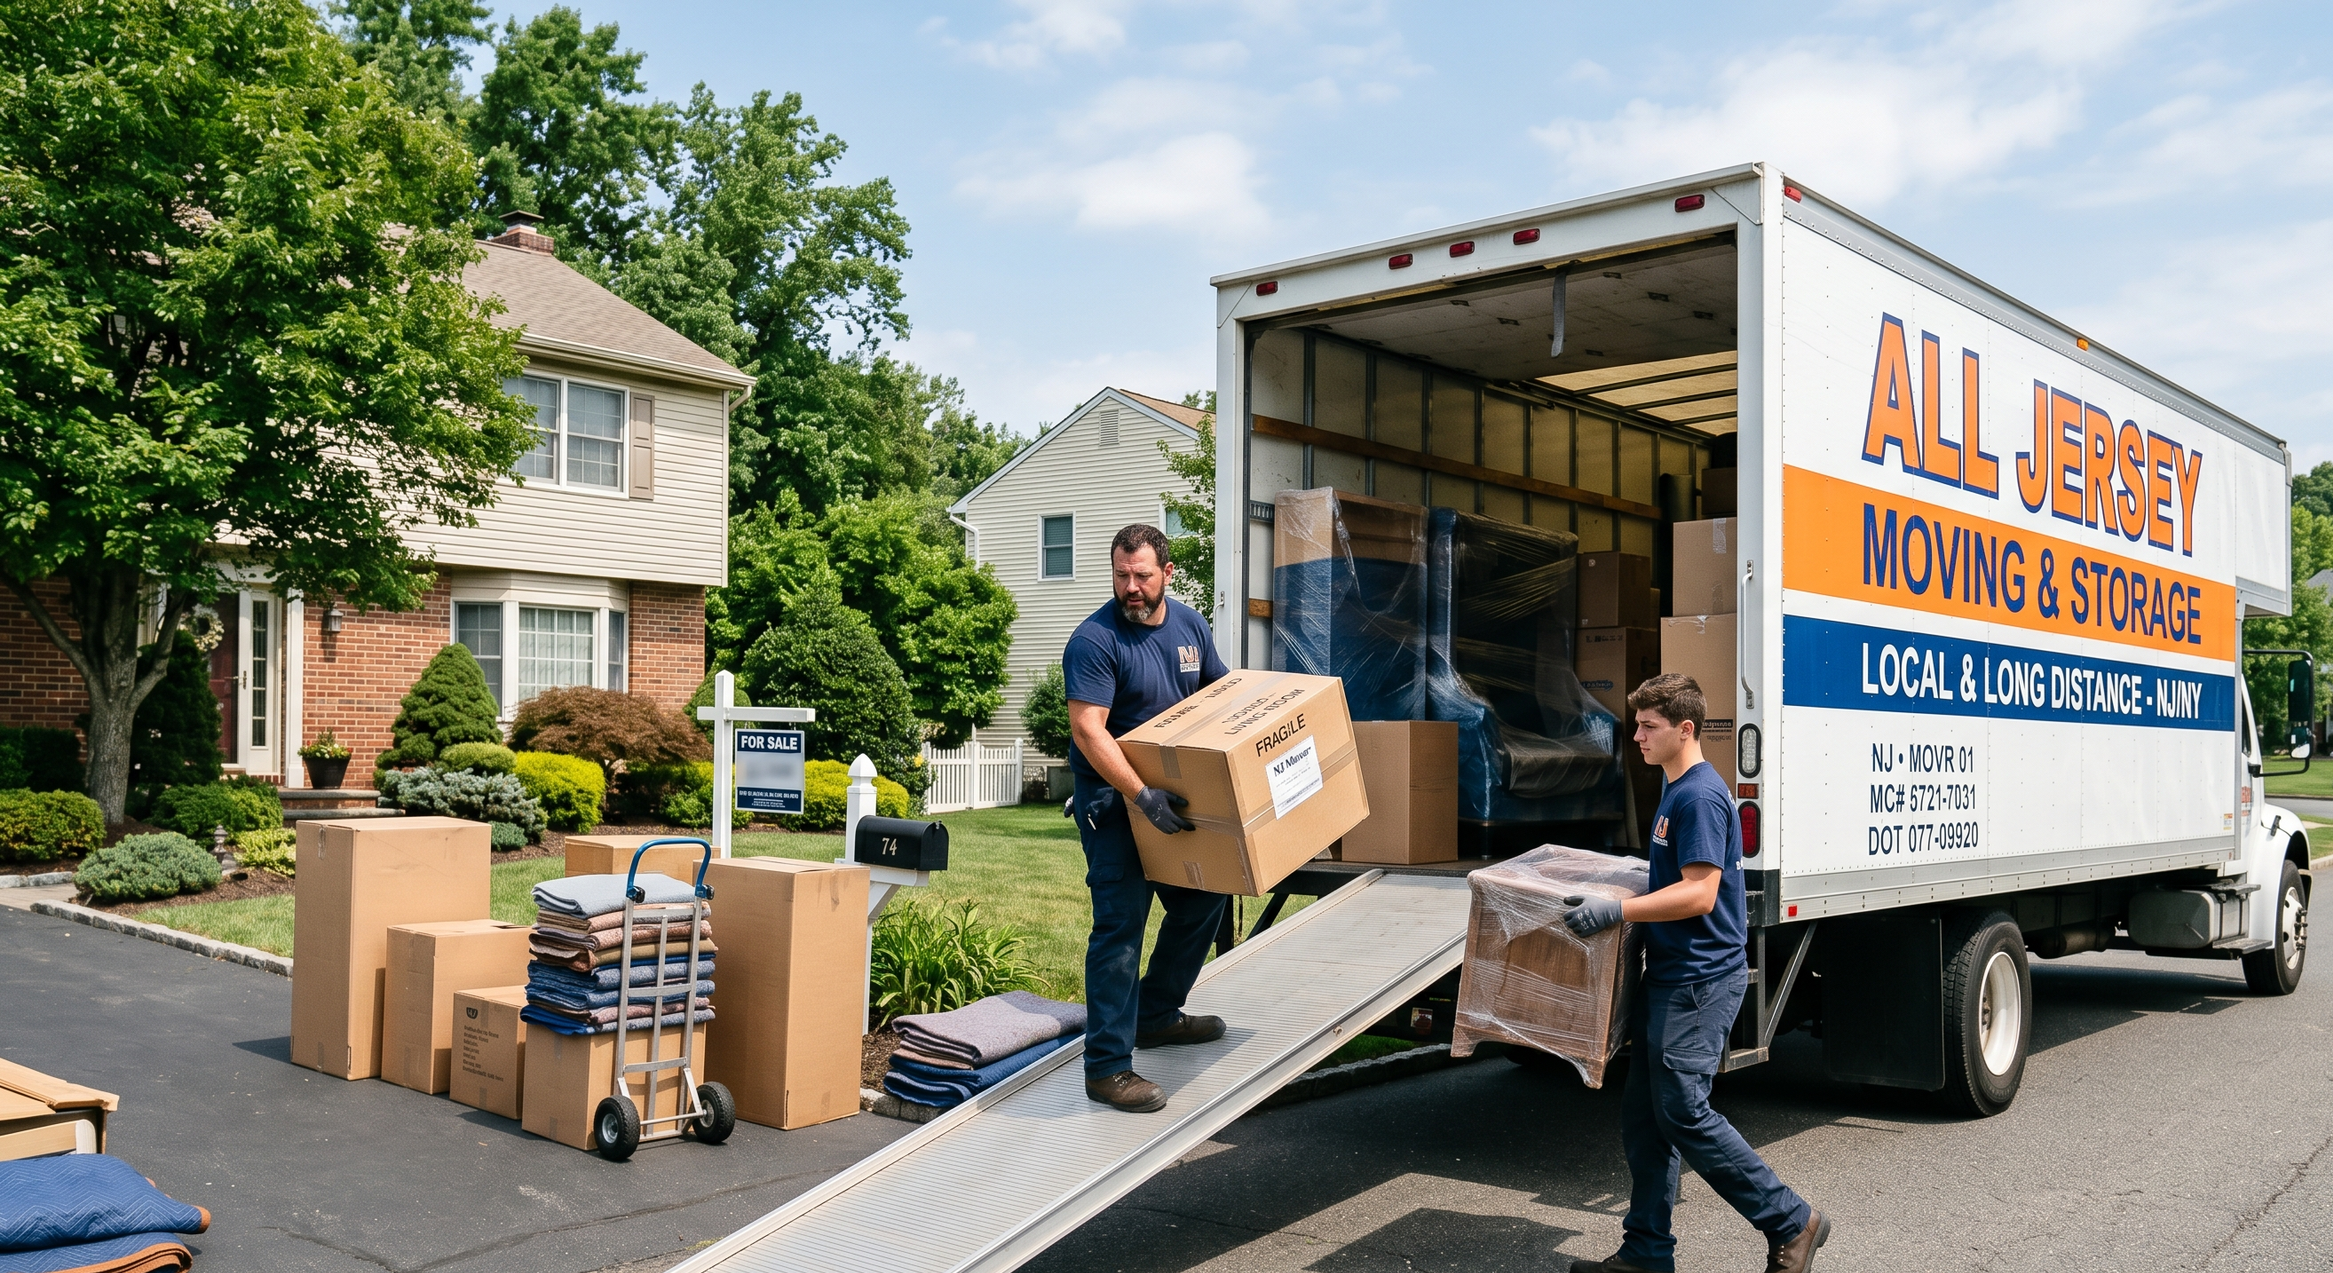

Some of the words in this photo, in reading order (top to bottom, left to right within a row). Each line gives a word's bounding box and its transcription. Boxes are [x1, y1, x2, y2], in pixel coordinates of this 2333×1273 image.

[1861, 312, 1999, 500] ALL
[2016, 378, 2203, 557] JERSEY
[1863, 502, 2025, 613] MOVING
[2038, 548, 2059, 619] &
[2071, 557, 2202, 645] STORAGE
[1862, 642, 1953, 700] LOCAL
[1960, 654, 1977, 702] &
[1983, 657, 2045, 708] LONG
[2051, 665, 2142, 715] DISTANCE
[741, 735, 765, 749] FOR
[767, 736, 798, 750] SALE
[1255, 713, 1306, 757] FRAGILE
[1872, 743, 1893, 773] NJ
[1909, 744, 1955, 773] MOVR
[1959, 746, 1974, 773] 01
[1870, 784, 1905, 813] MC#
[882, 837, 898, 856] 74
[1868, 825, 1904, 856] DOT
[1908, 821, 1979, 853] 077-09920
